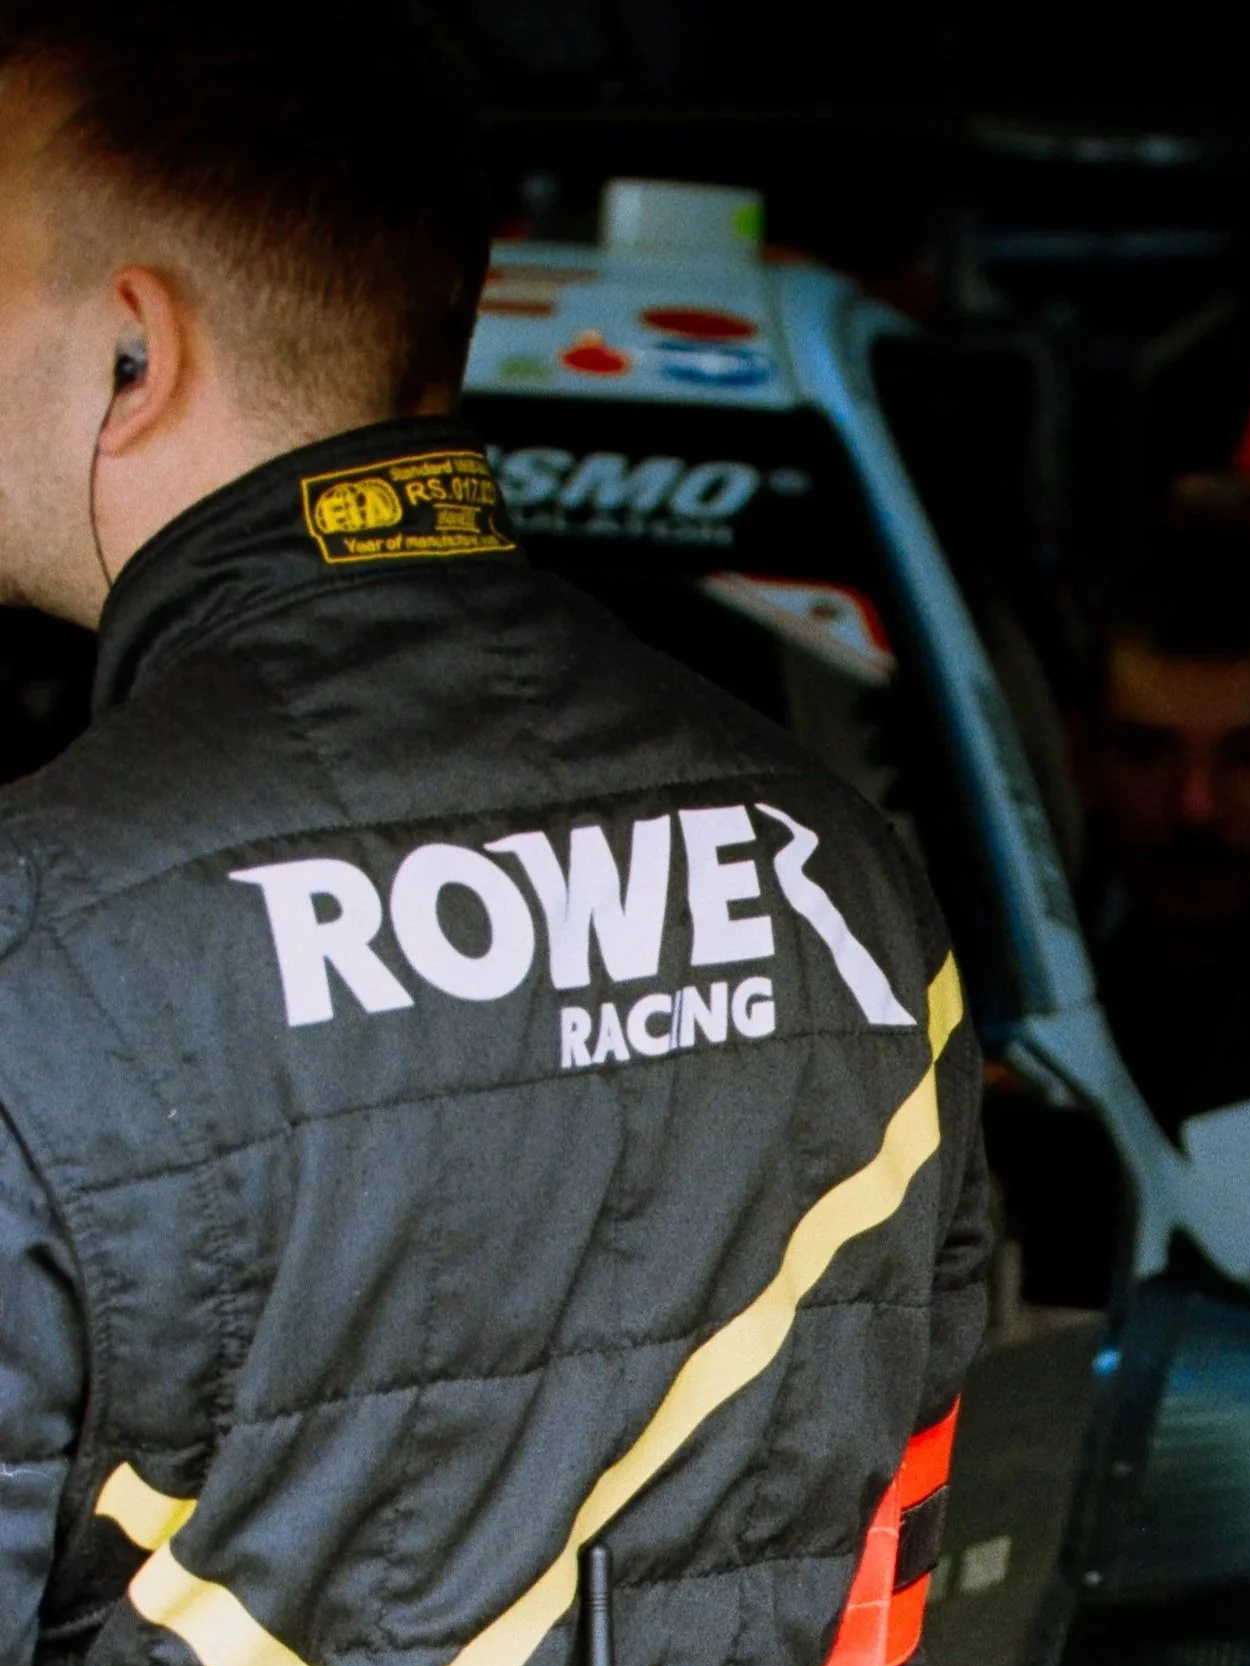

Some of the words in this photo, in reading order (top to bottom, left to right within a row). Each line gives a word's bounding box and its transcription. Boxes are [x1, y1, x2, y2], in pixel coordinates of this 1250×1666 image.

[486, 446, 760, 519] SMO
[228, 805, 775, 1027] ROWE
[560, 976, 776, 1070] RACING
